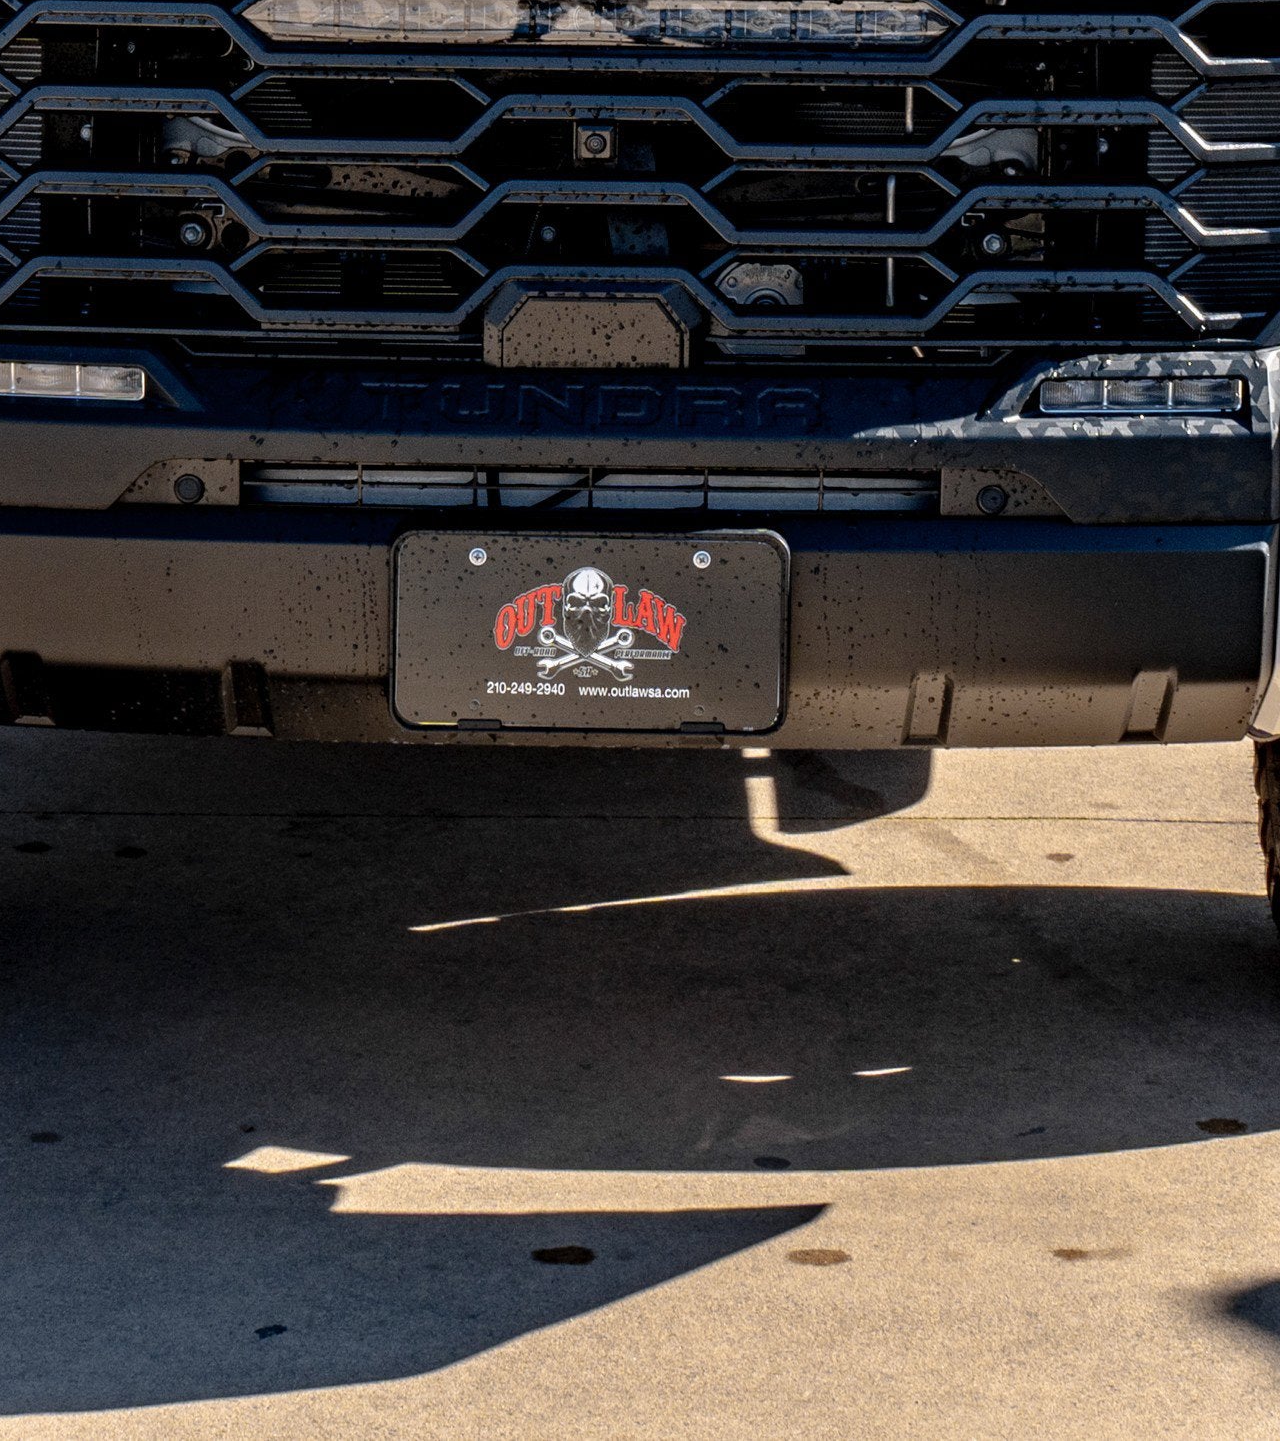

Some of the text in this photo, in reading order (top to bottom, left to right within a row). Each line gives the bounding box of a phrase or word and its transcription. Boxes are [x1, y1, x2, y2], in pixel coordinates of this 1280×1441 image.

[361, 380, 821, 432] TUNDRA
[486, 680, 690, 699] 210-249-2940 www.outlawsa.com
